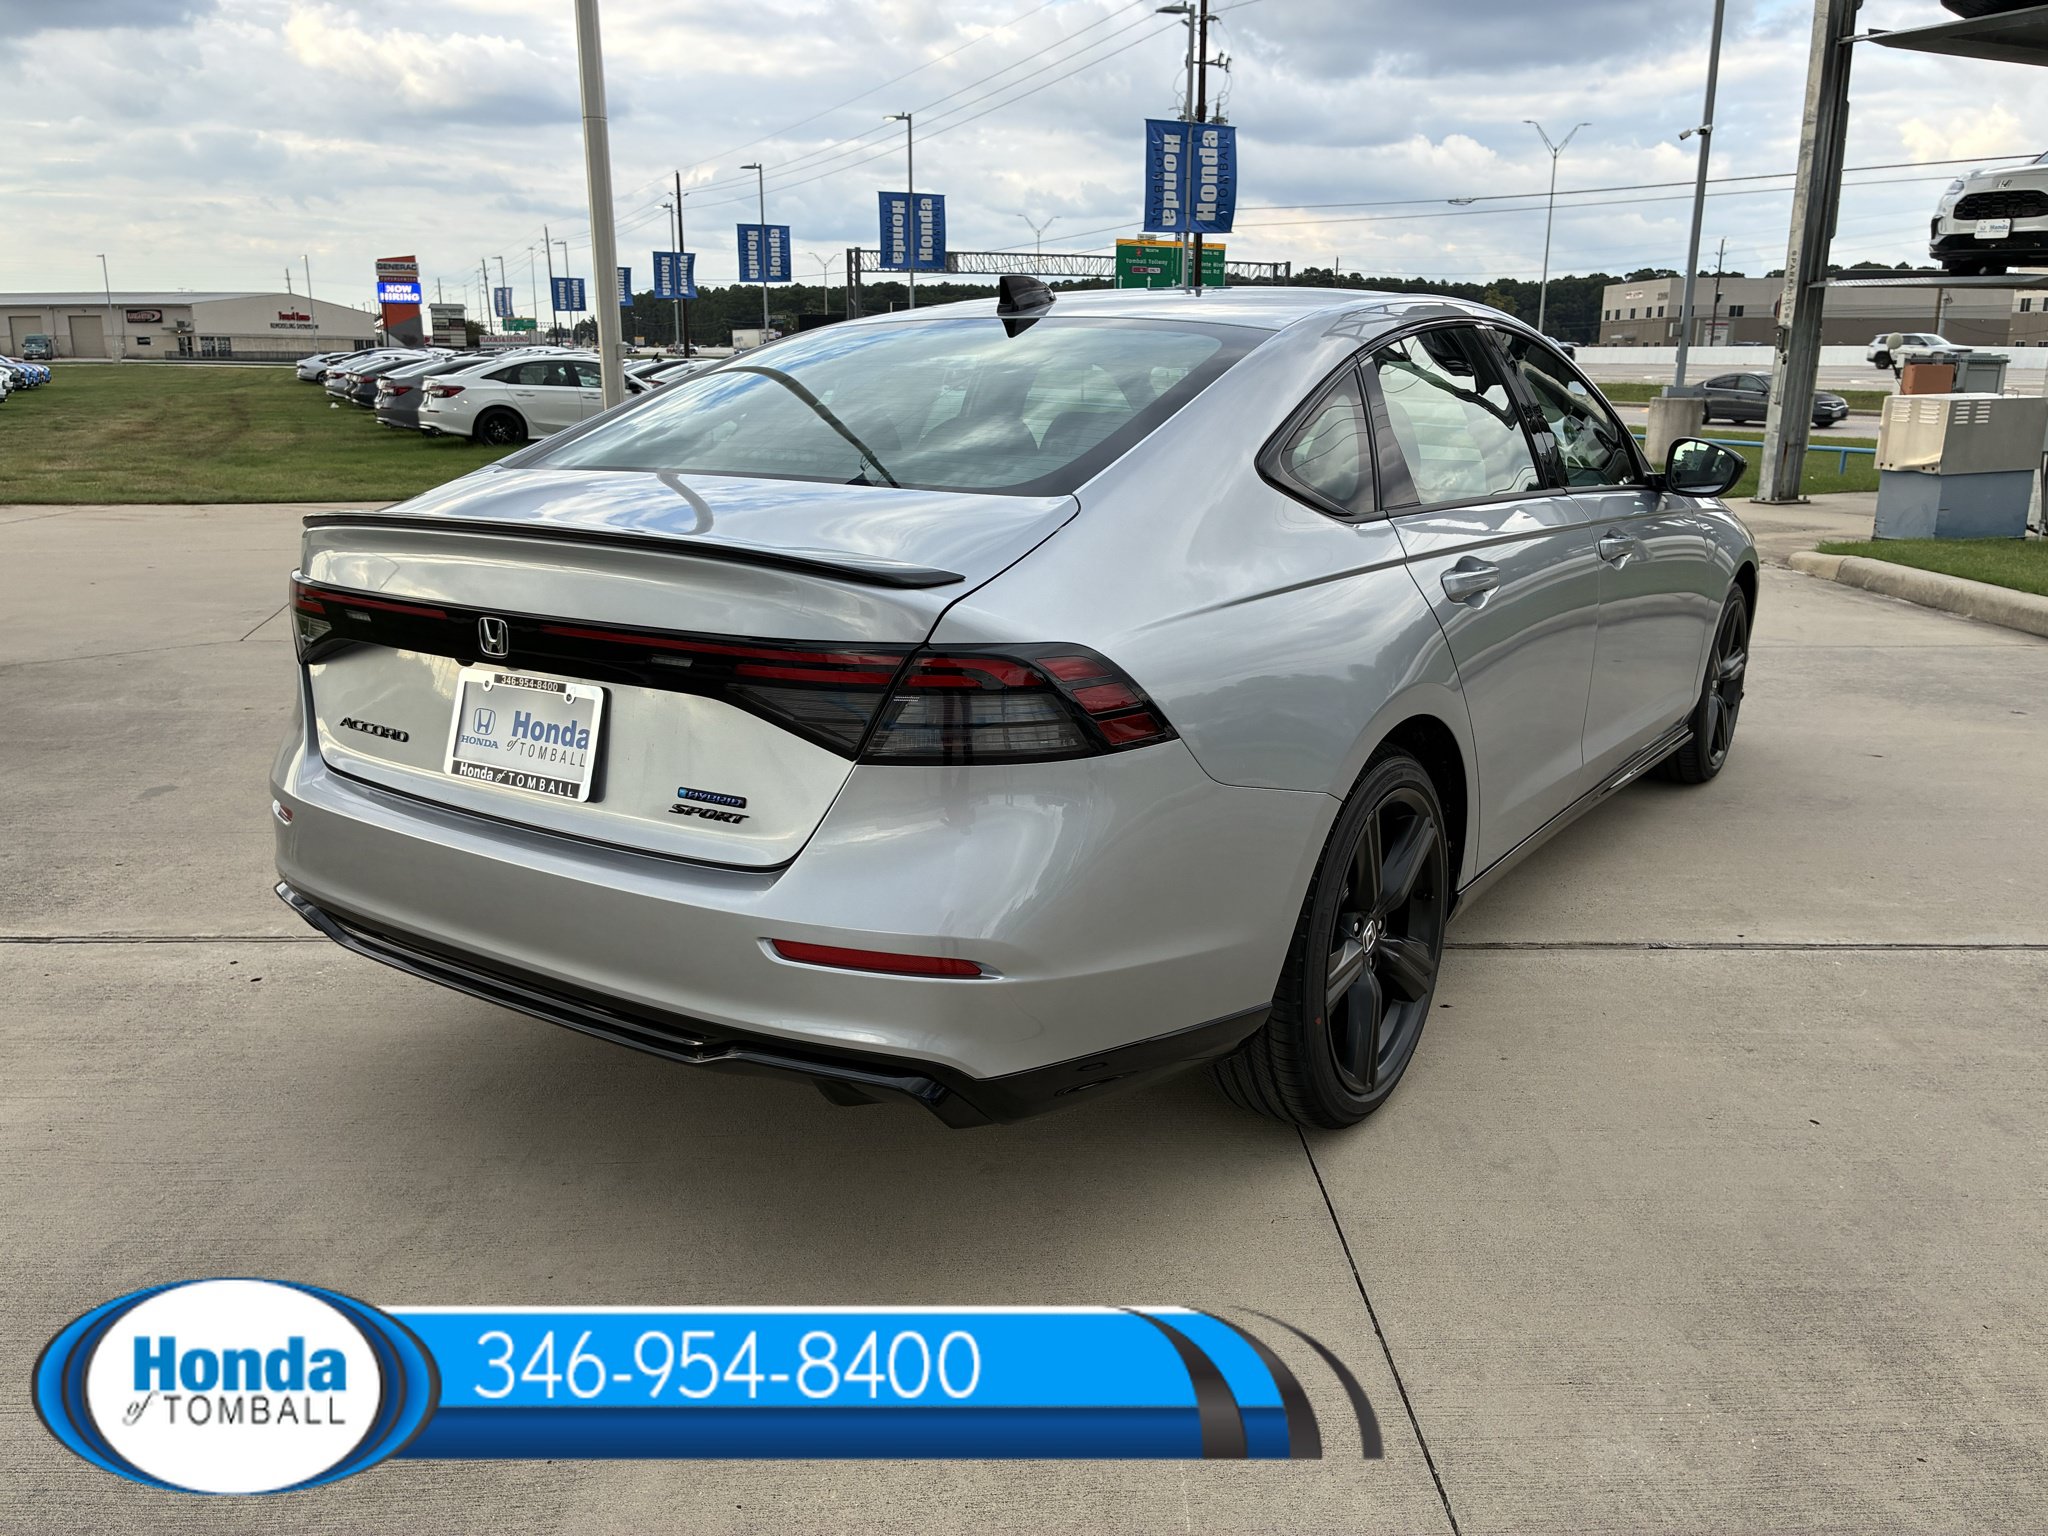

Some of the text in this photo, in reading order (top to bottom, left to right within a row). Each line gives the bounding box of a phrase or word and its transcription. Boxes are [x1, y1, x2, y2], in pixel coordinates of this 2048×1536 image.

[1162, 134, 1181, 226] Honda
[1196, 130, 1218, 221] Honda
[377, 263, 417, 271] GENERAC
[747, 230, 760, 279] Honda
[769, 228, 782, 277] Honda
[385, 284, 413, 293] NOW
[661, 256, 672, 296] Honda
[679, 255, 689, 294] Honda
[380, 292, 420, 302] HIRING
[558, 281, 567, 310] Honda
[340, 716, 409, 743] ACCORD
[460, 734, 499, 749] HONDA
[511, 710, 590, 750] Honda
[506, 738, 585, 768] of TOMBALL
[459, 762, 574, 797] Honda of TOMBALL
[687, 790, 741, 807] HYBRID
[668, 803, 750, 825] SPORT
